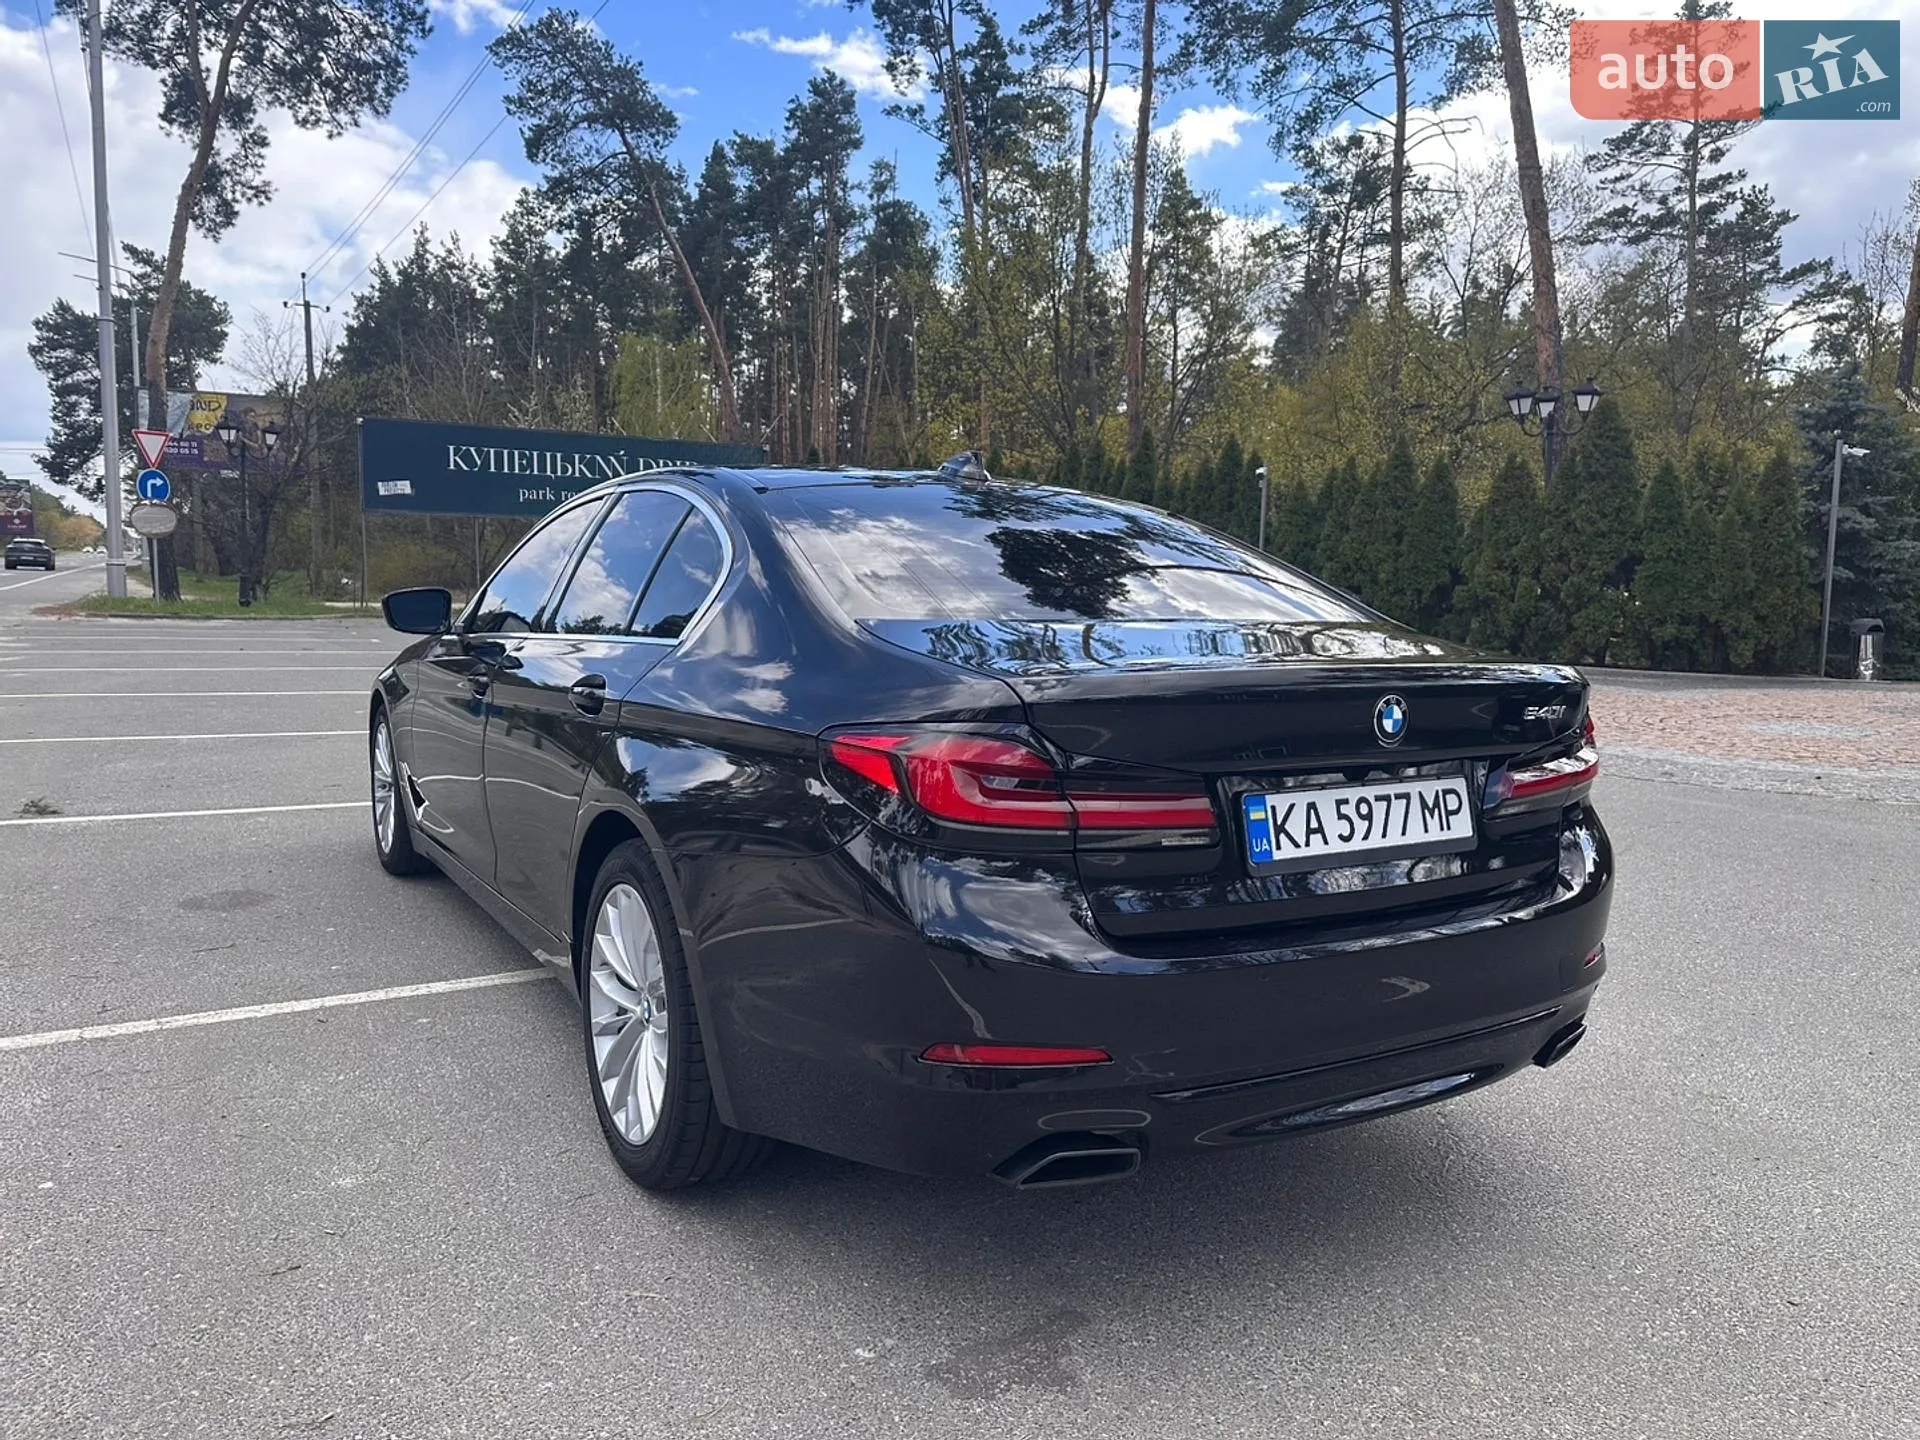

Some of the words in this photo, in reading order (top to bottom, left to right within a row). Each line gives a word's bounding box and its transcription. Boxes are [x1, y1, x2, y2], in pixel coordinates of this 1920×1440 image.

[519, 486, 556, 502] park
[1270, 801, 1330, 851] KA
[1335, 792, 1412, 843] 5977
[1418, 787, 1464, 834] MP
[1253, 838, 1271, 853] UA
